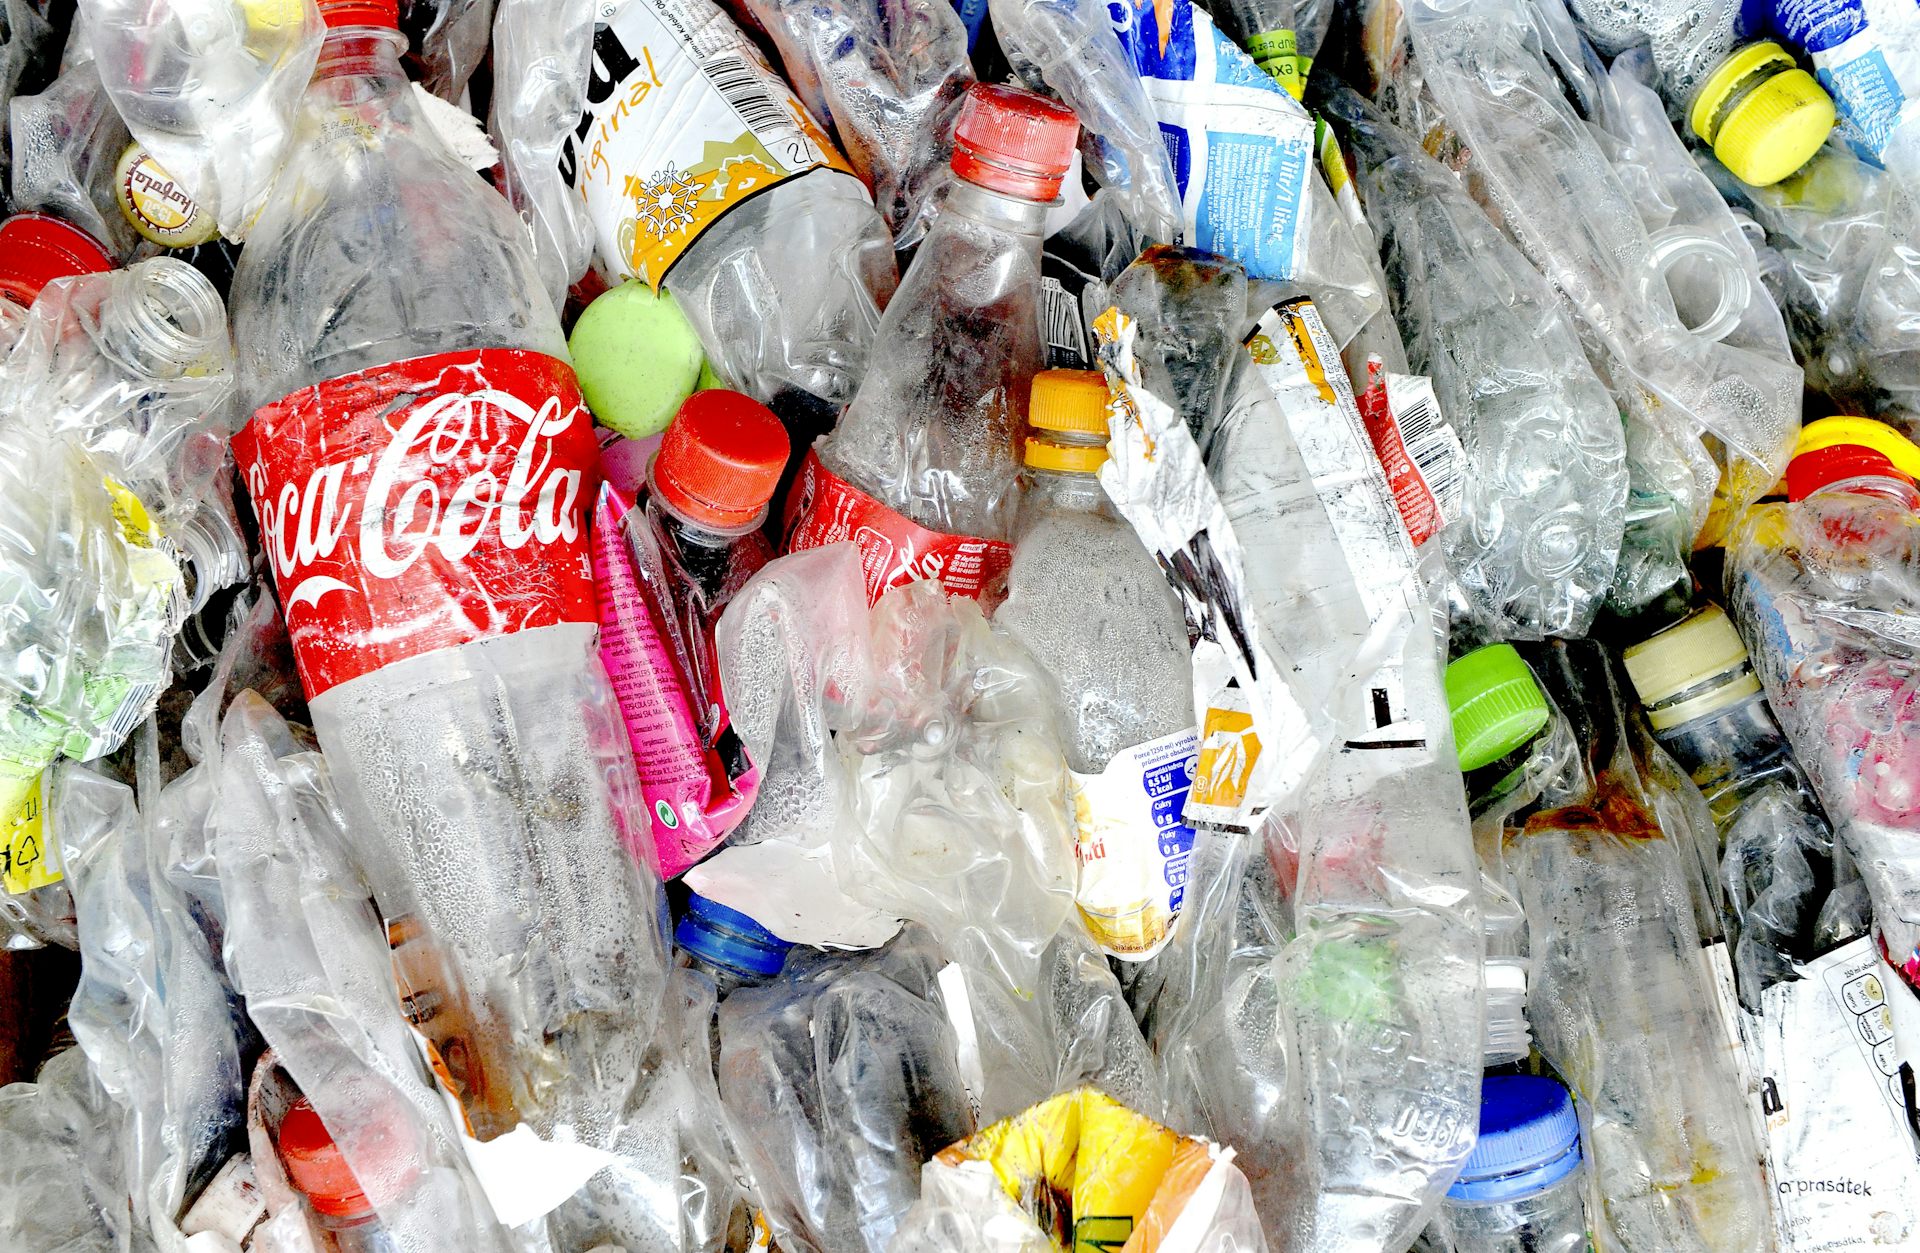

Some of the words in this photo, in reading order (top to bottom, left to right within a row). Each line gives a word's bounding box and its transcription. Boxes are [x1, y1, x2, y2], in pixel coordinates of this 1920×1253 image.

[580, 46, 663, 204] riginal
[135, 170, 192, 213] kofola
[1155, 783, 1175, 792] kcal
[1153, 800, 1173, 809] Cukry
[1160, 831, 1177, 839] Tuky
[1797, 1176, 1872, 1197] prasátek
